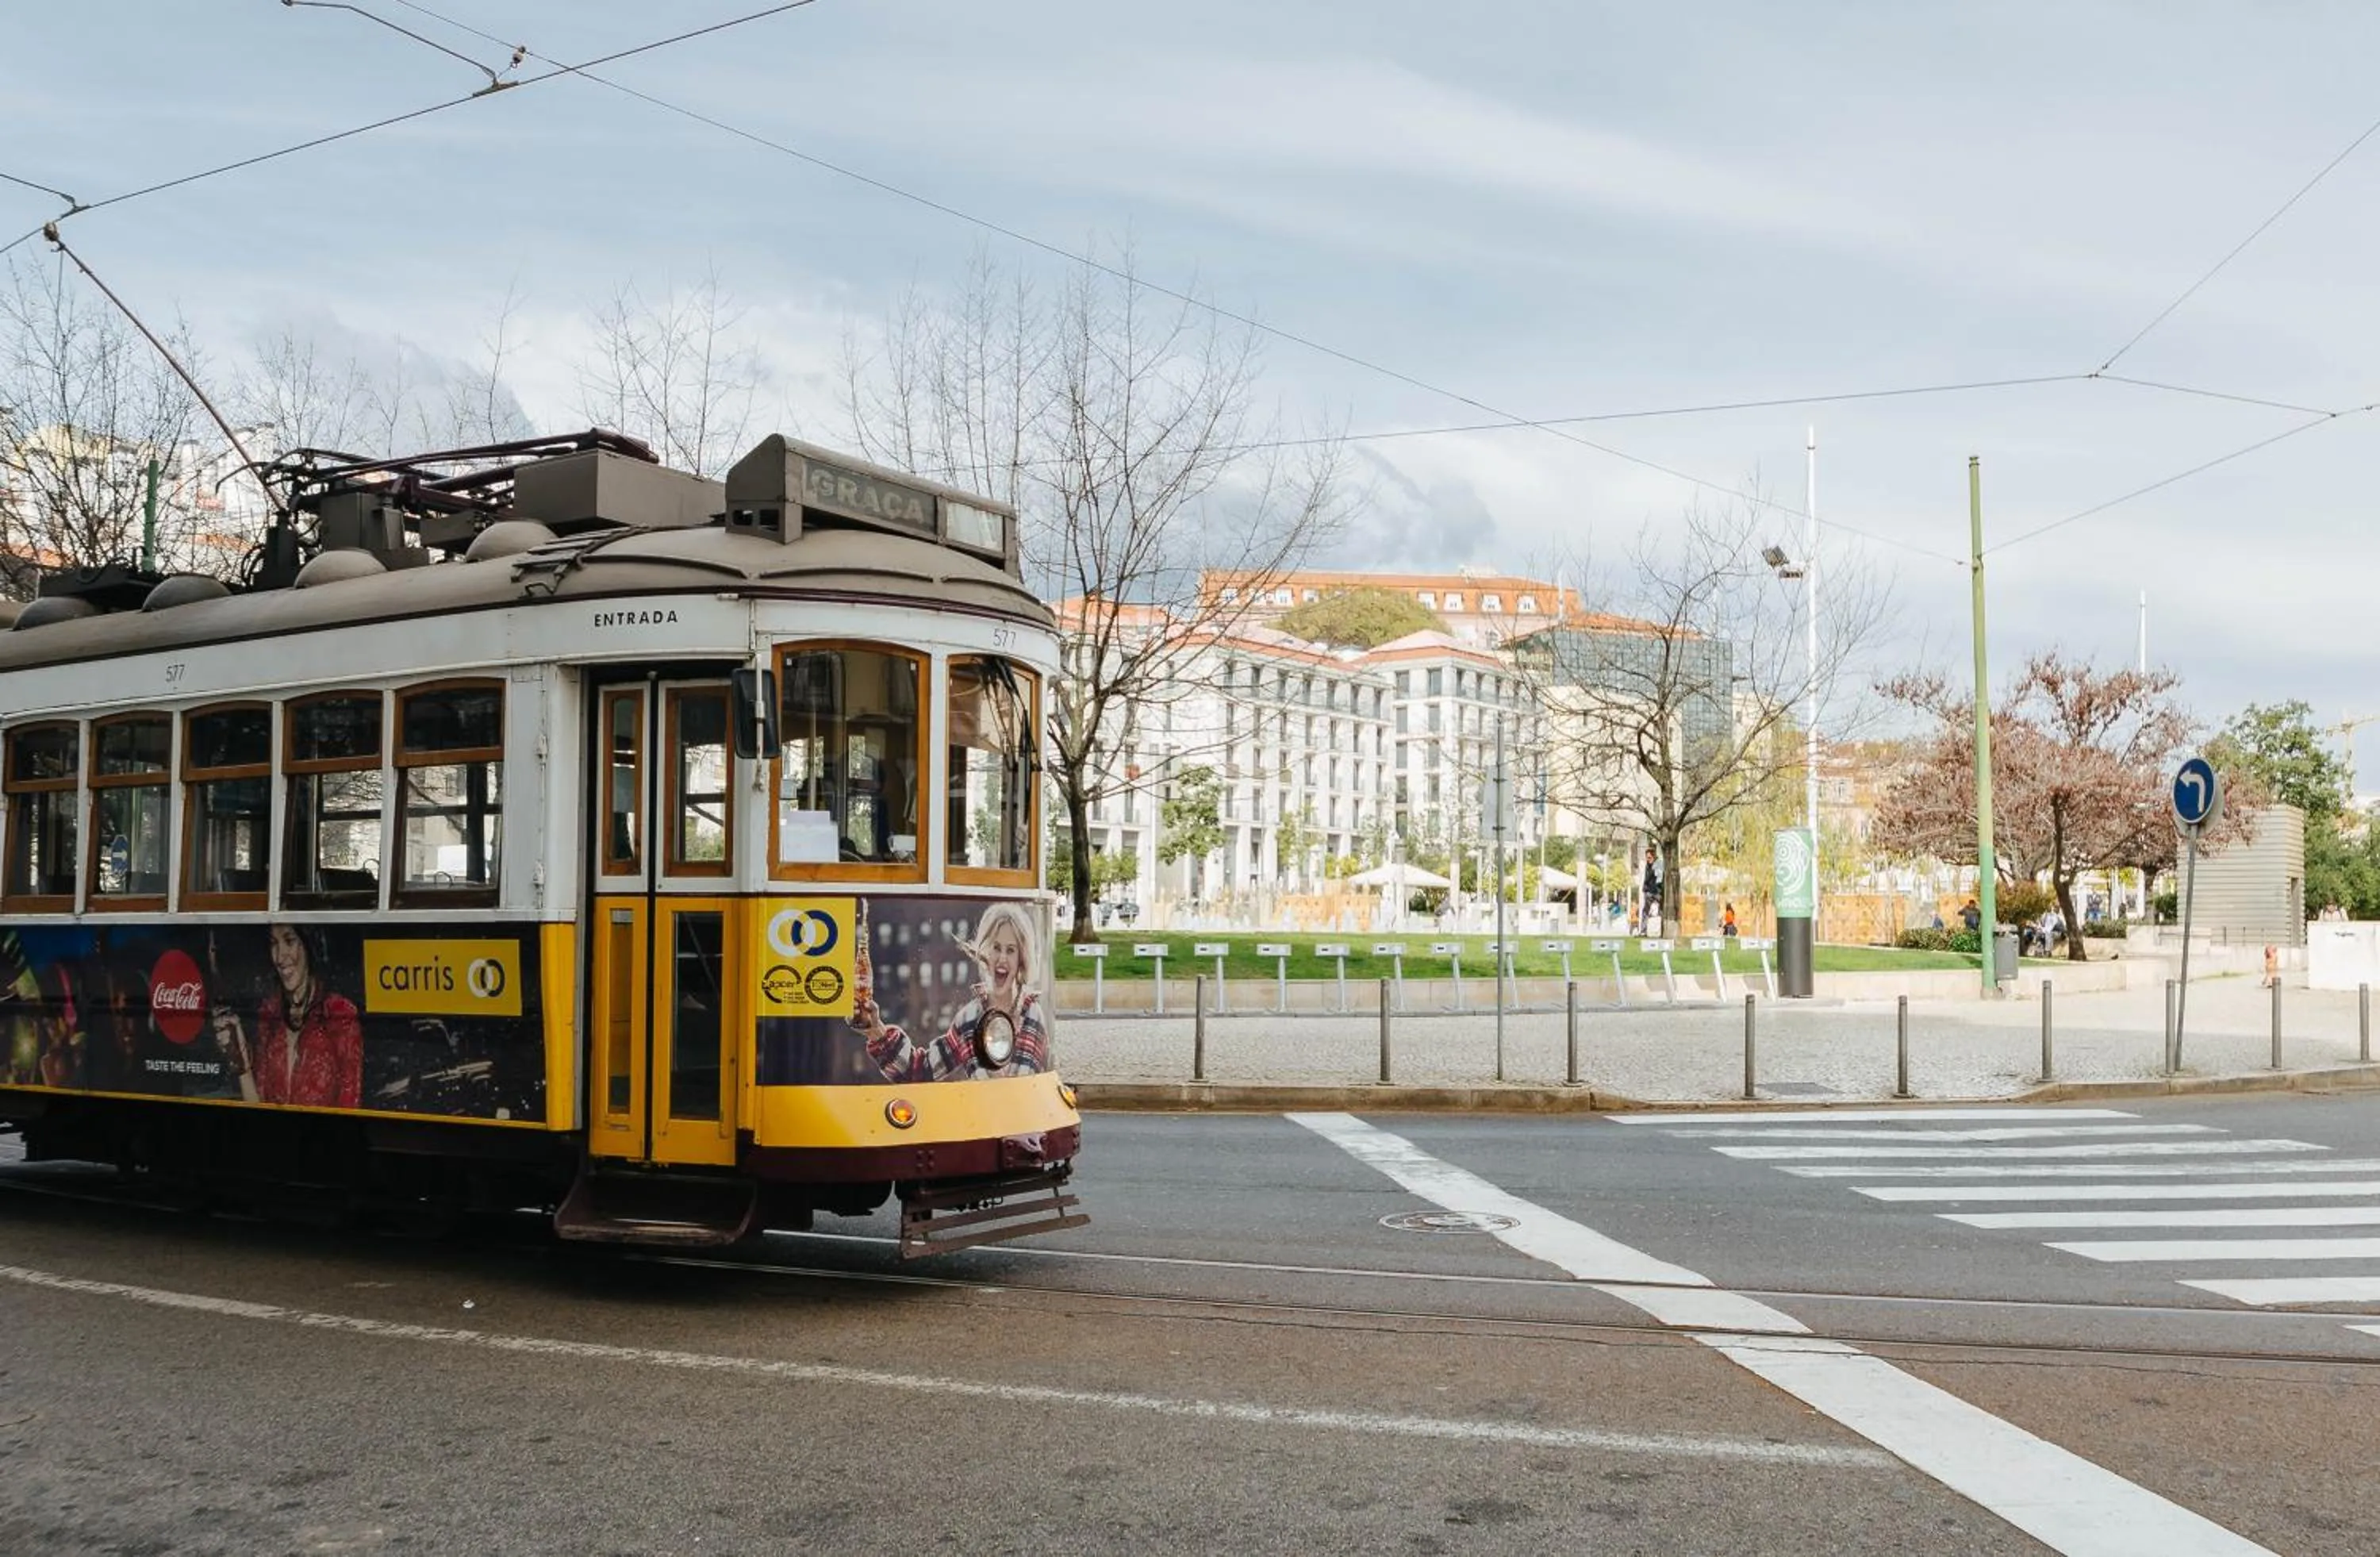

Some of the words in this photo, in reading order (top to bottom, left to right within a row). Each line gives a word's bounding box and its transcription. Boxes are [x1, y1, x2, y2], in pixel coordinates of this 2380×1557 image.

[811, 469, 925, 524] GRAÇA
[594, 610, 678, 627] ENTRADA
[993, 628, 1016, 648] 577
[166, 664, 185, 682] 577
[378, 955, 455, 990] carris
[145, 1059, 169, 1072] TASTE
[170, 1060, 185, 1073] THE
[186, 1061, 220, 1074] FEELING
